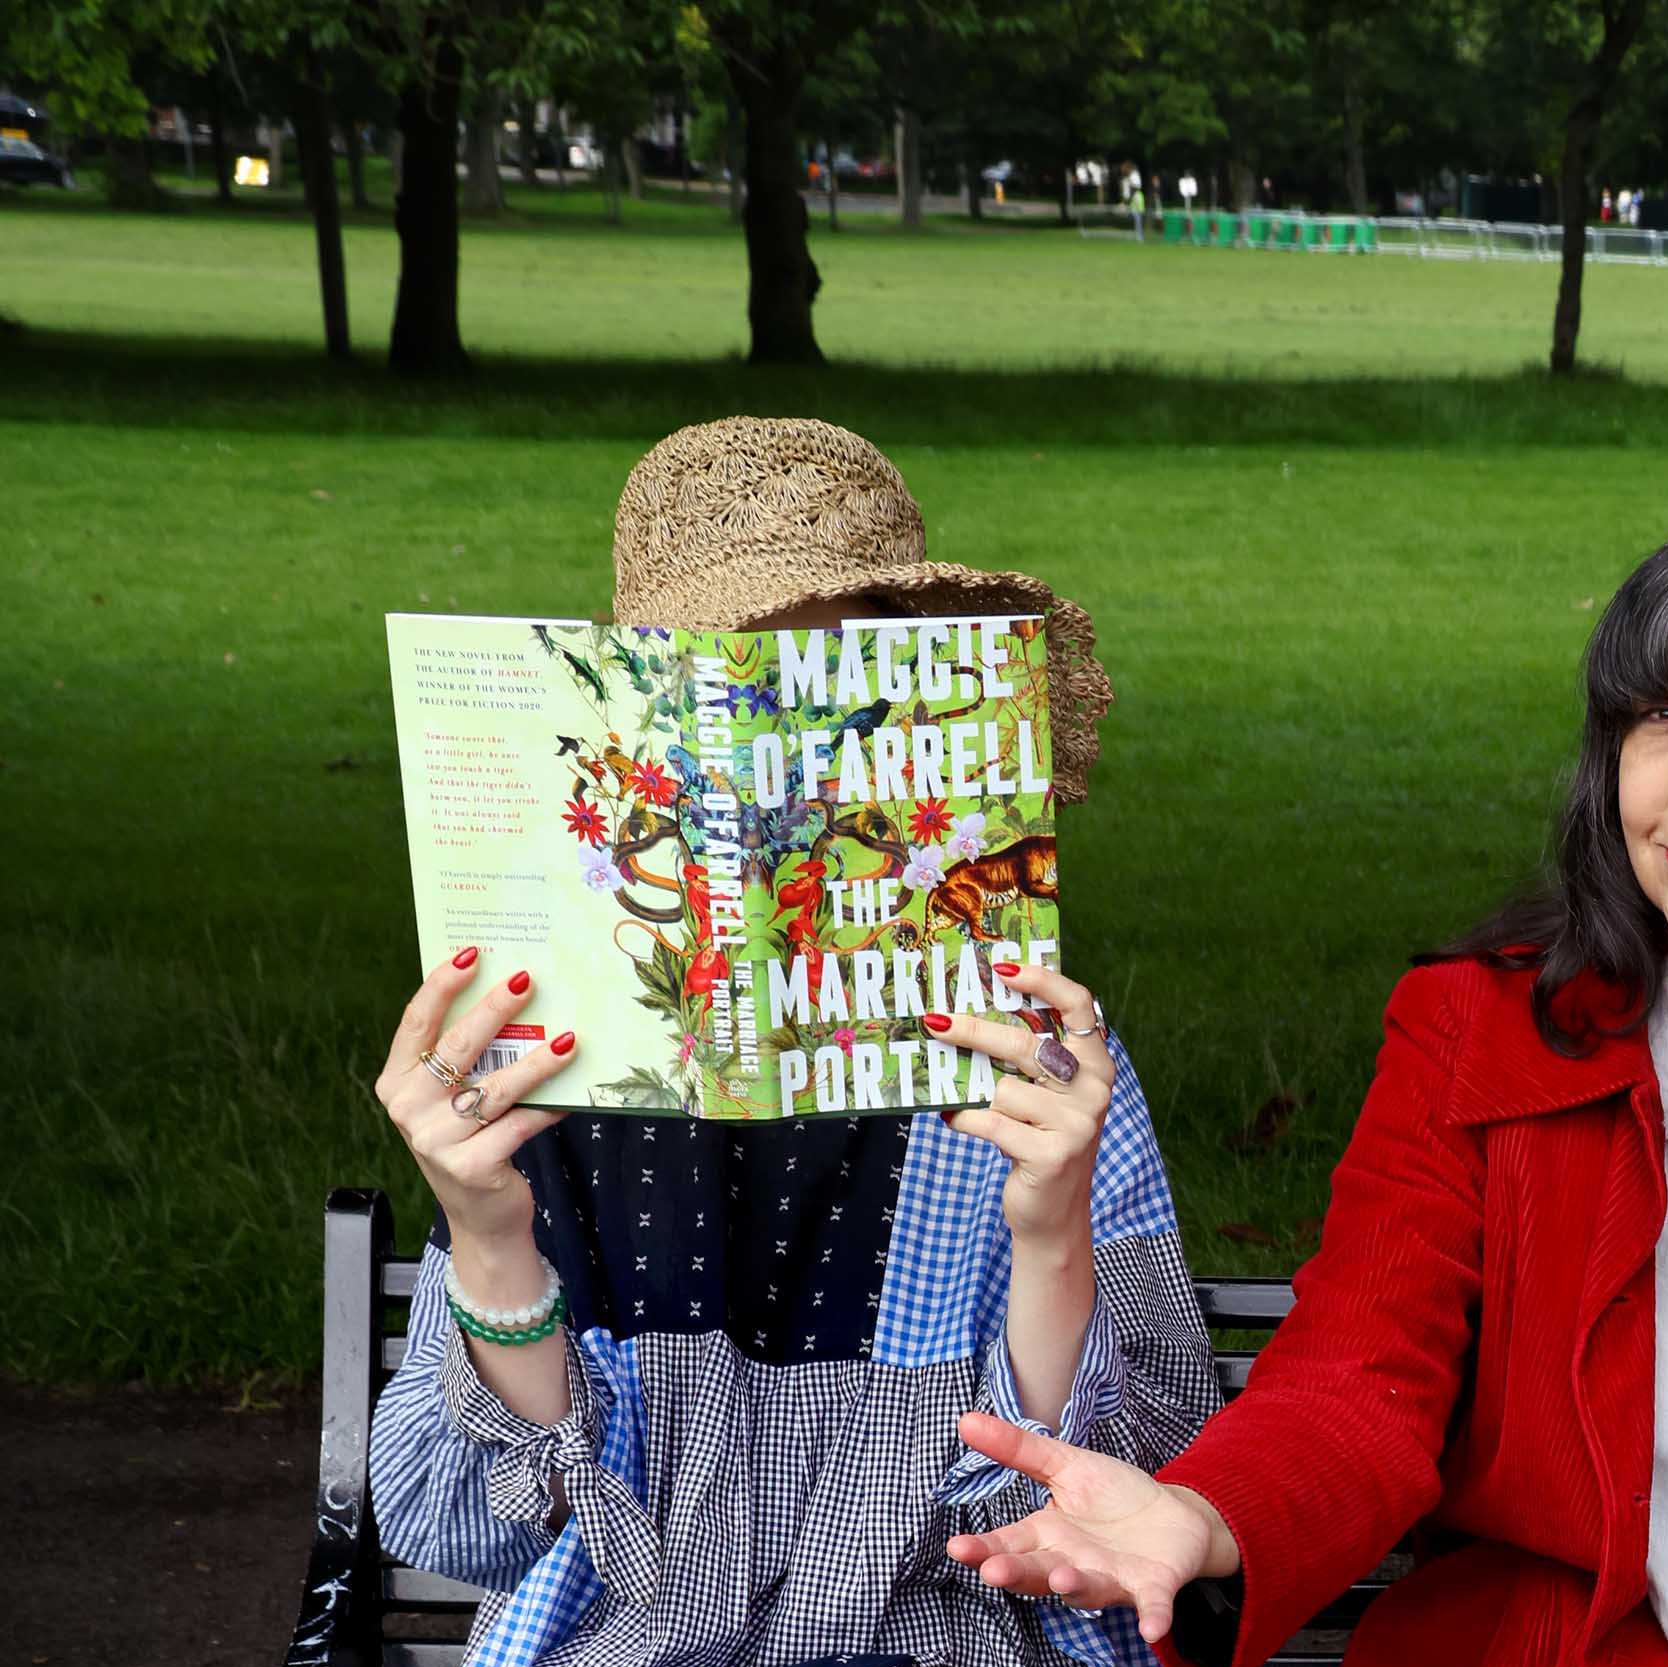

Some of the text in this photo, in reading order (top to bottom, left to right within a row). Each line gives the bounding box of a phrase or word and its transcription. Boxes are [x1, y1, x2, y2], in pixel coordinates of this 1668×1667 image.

[779, 621, 1015, 707] MAGGIE
[693, 656, 747, 951] MAGGIE O'FARRELL
[753, 720, 1049, 809] O'FARRELL
[827, 879, 900, 928] THE
[735, 960, 752, 990] THE
[768, 939, 1057, 1029] MARRIAGE
[712, 979, 733, 1053] PORTRAIT
[736, 997, 759, 1073] MARRIAGE
[779, 1038, 996, 1118] PORTRA
